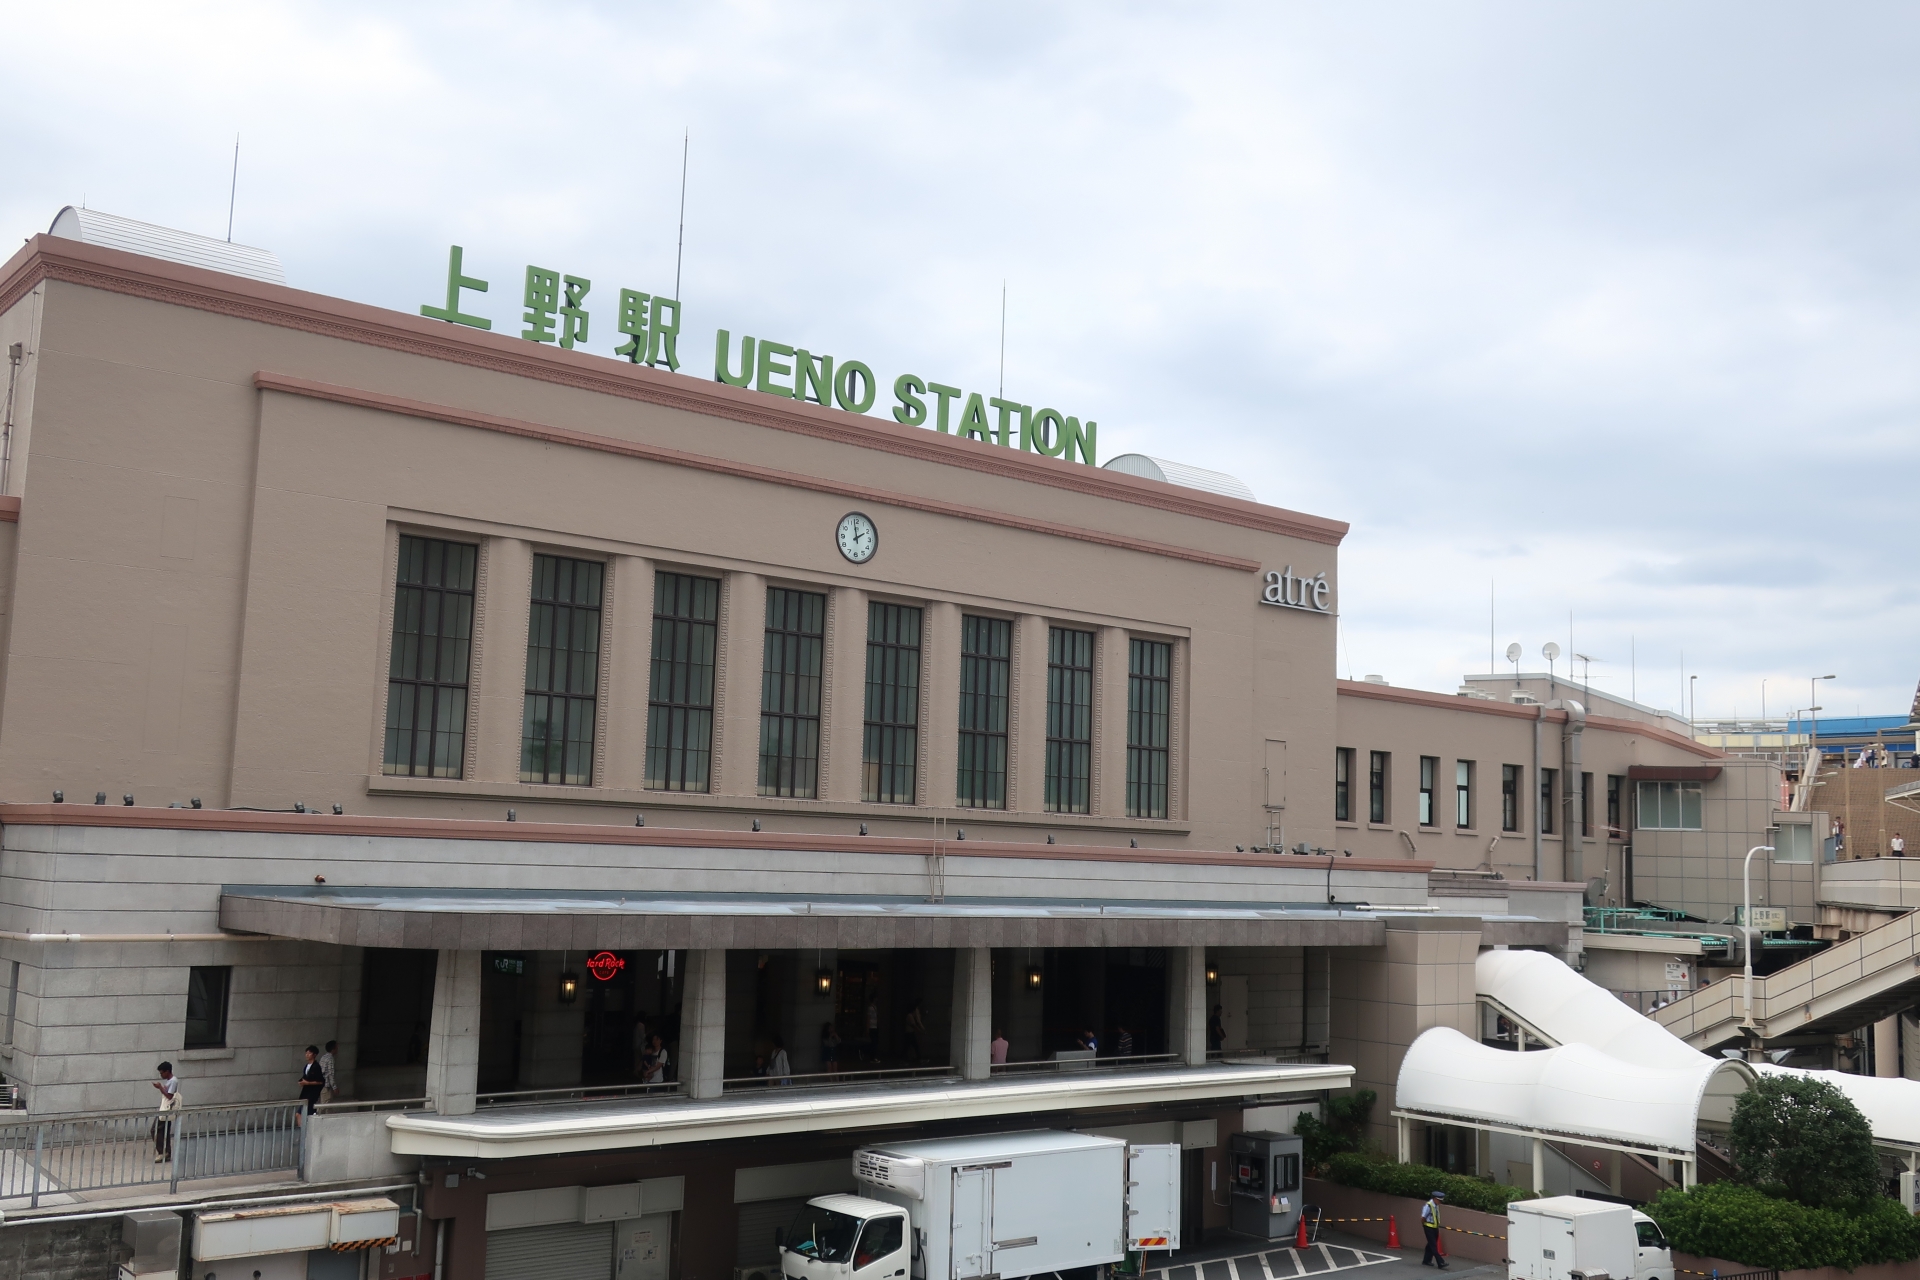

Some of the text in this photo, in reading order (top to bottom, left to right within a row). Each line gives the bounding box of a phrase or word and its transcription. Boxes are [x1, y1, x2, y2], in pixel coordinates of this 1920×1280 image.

[420, 245, 1097, 466] 上野駅 UENO STATION
[1262, 565, 1330, 610] atré
[605, 957, 625, 969] Rock
